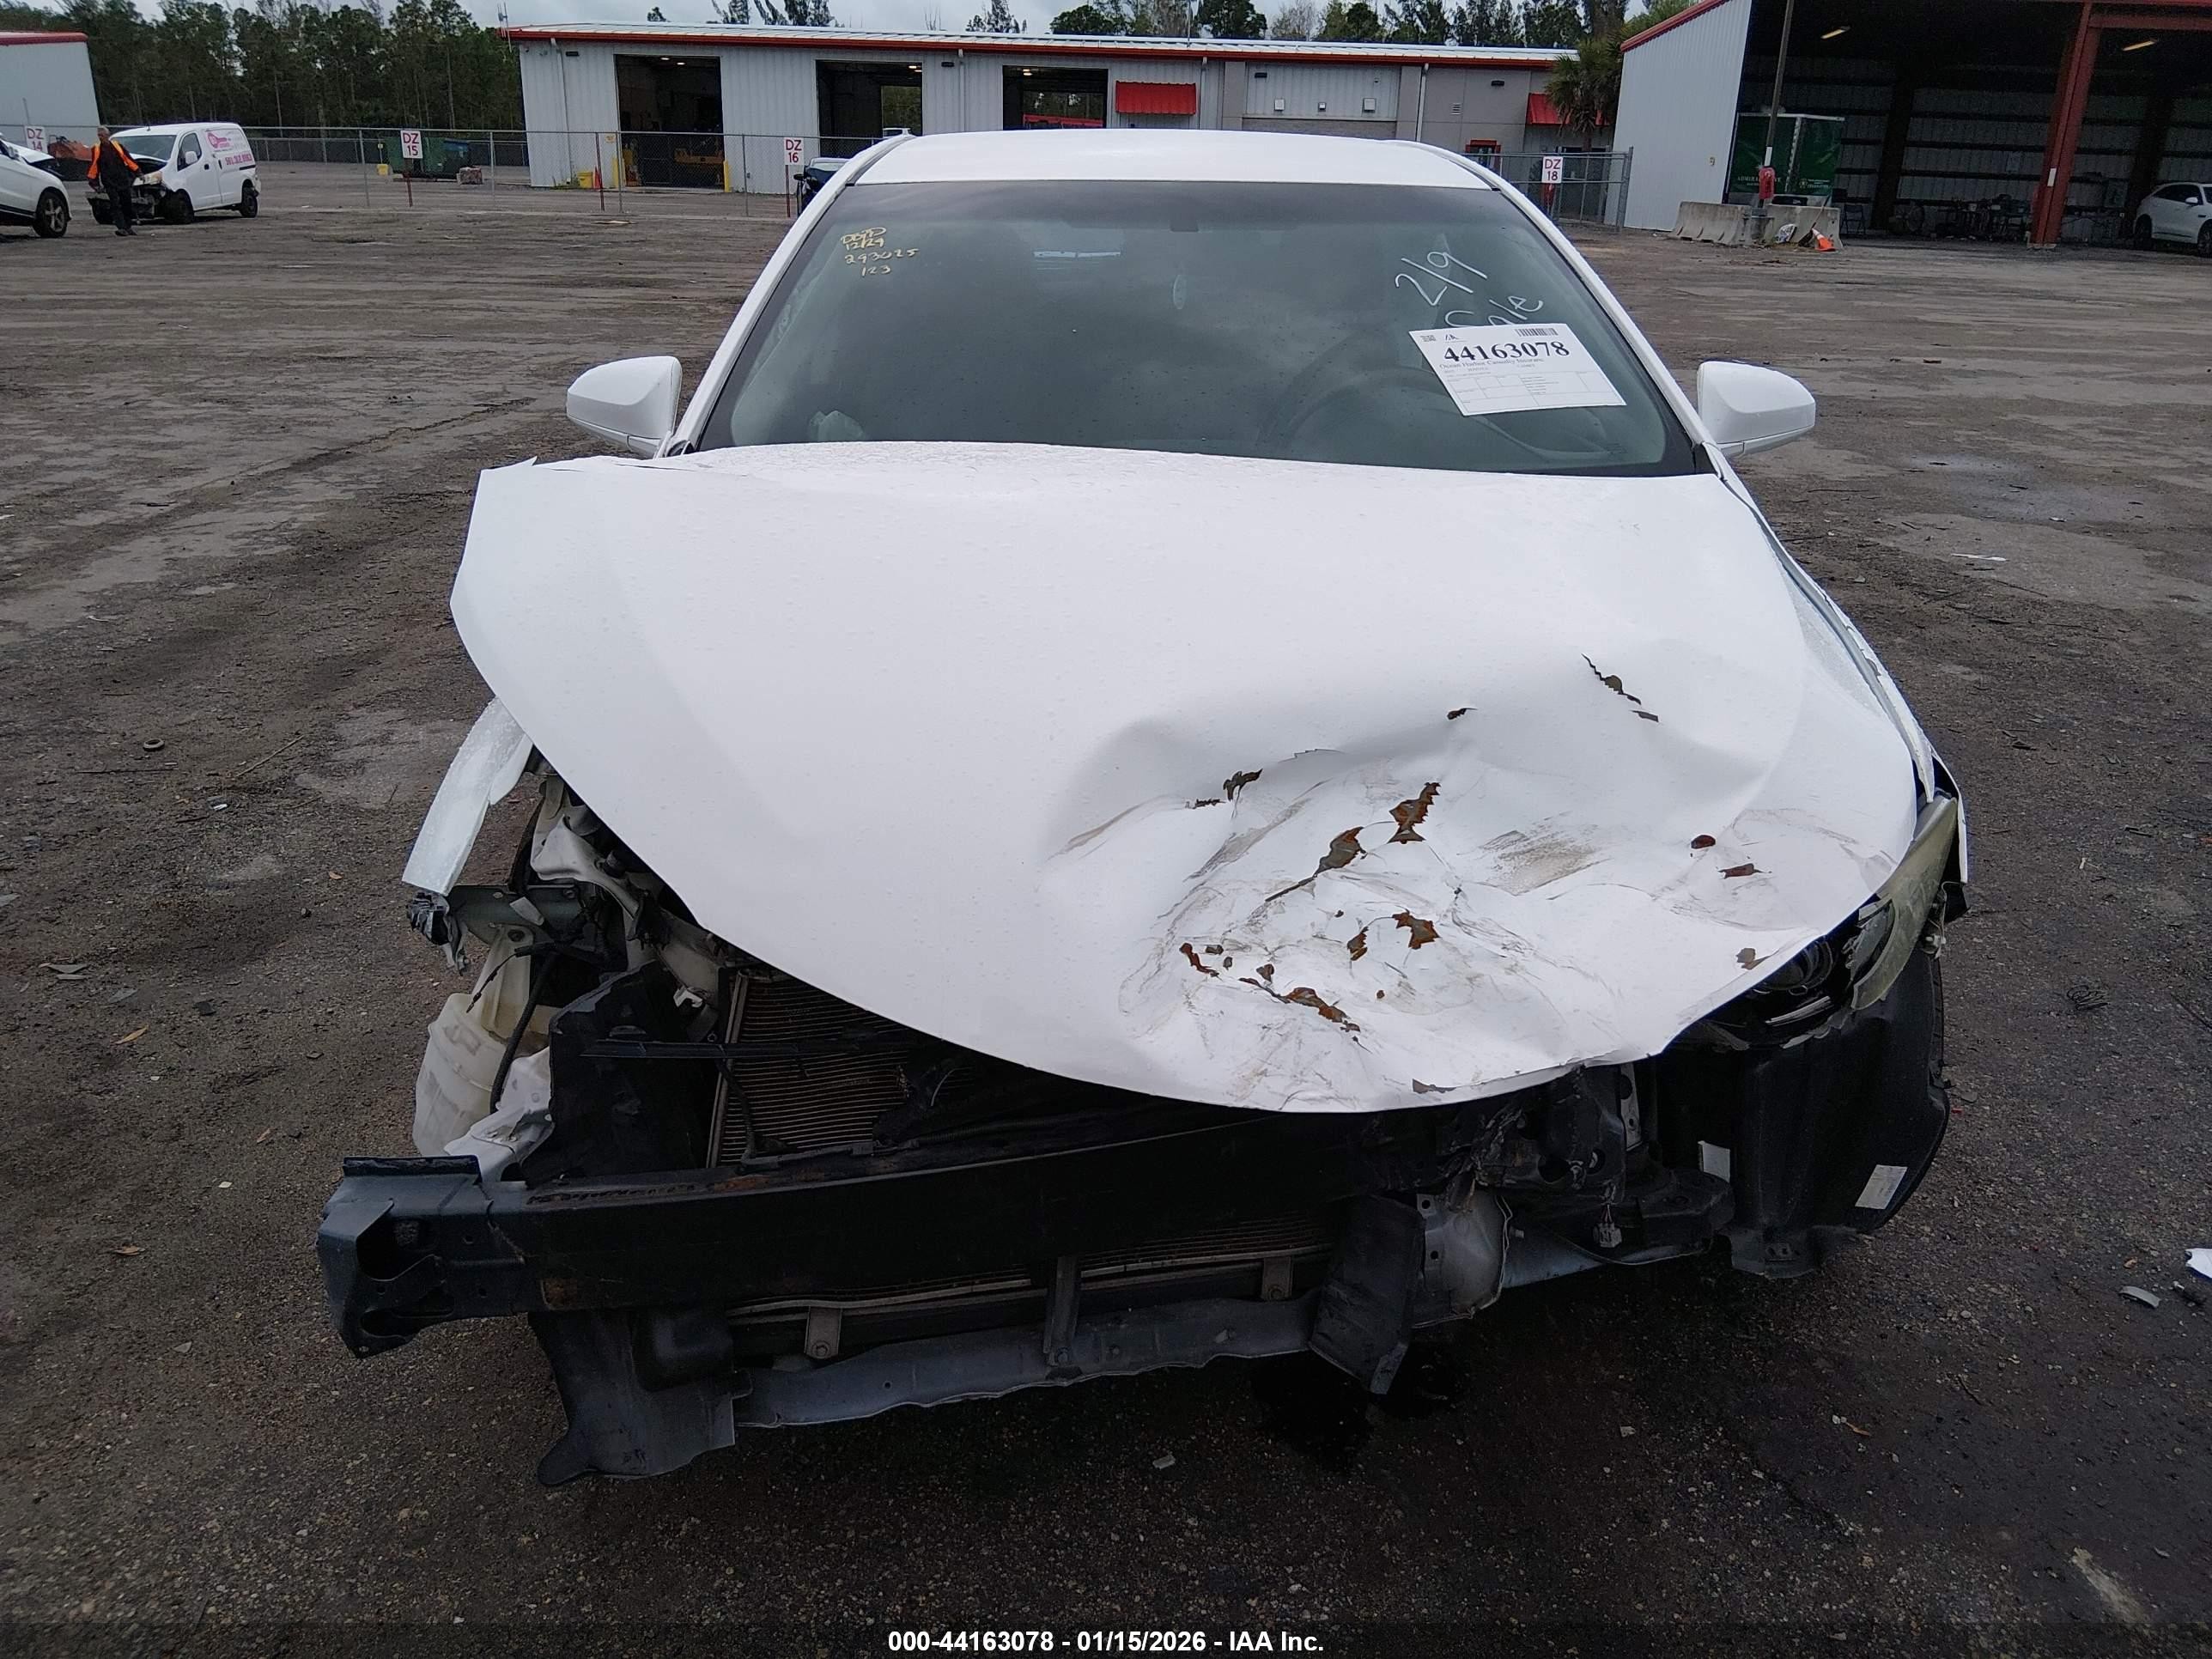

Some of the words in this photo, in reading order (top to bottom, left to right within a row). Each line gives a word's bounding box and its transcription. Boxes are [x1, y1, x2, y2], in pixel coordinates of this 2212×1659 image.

[27, 128, 44, 139] DZ
[403, 132, 420, 144] DZ
[407, 145, 418, 156] 15
[786, 139, 802, 151] DZ
[788, 151, 799, 163] 16
[1545, 158, 1561, 170] DZ
[1547, 170, 1559, 181] 18
[861, 264, 891, 277] 123
[1395, 251, 1488, 307] 2/9
[1443, 341, 1571, 362] 44163078
